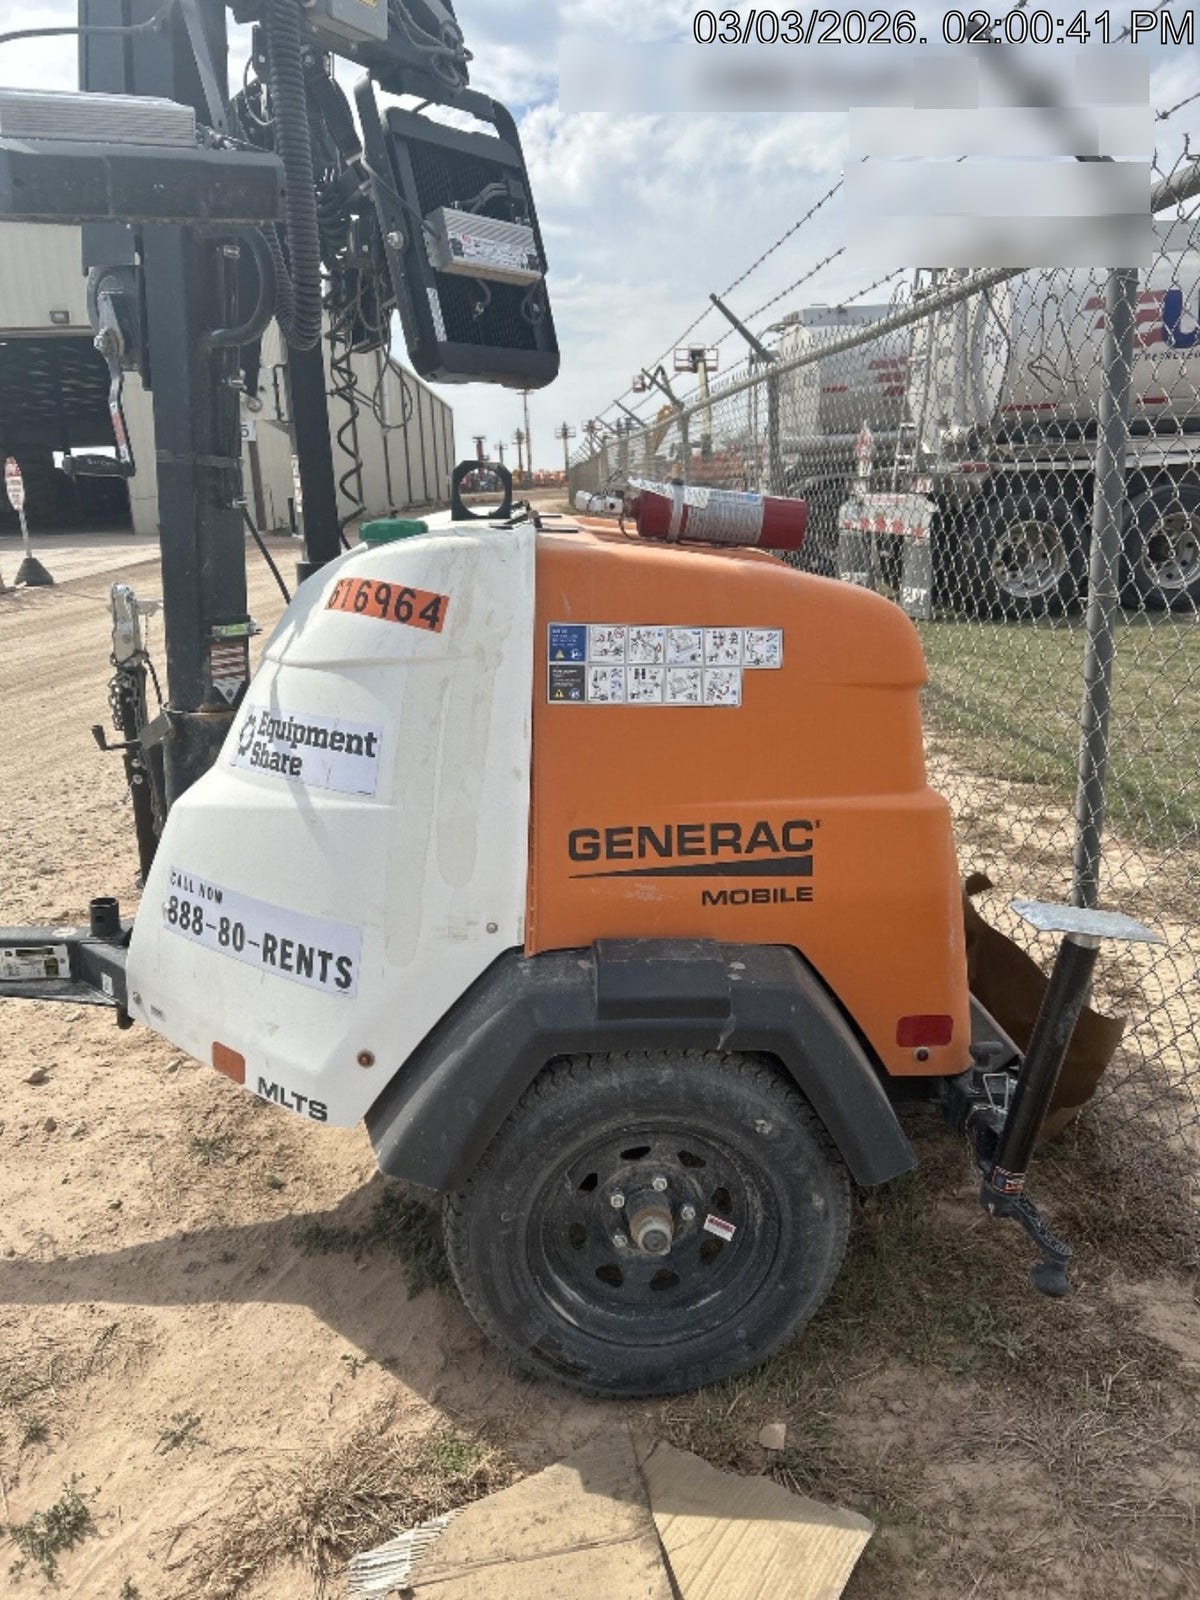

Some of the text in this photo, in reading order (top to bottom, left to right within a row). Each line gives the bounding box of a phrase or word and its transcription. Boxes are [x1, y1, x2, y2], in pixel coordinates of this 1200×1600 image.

[326, 578, 442, 631] 616964
[257, 711, 377, 758] Equipment
[250, 741, 303, 776] Share
[568, 820, 814, 862] GENERAC
[170, 872, 223, 904] CALL NOW
[701, 886, 814, 906] MOBILE
[168, 896, 353, 989] 888-80-RENTS
[257, 1077, 328, 1122] MLTS
